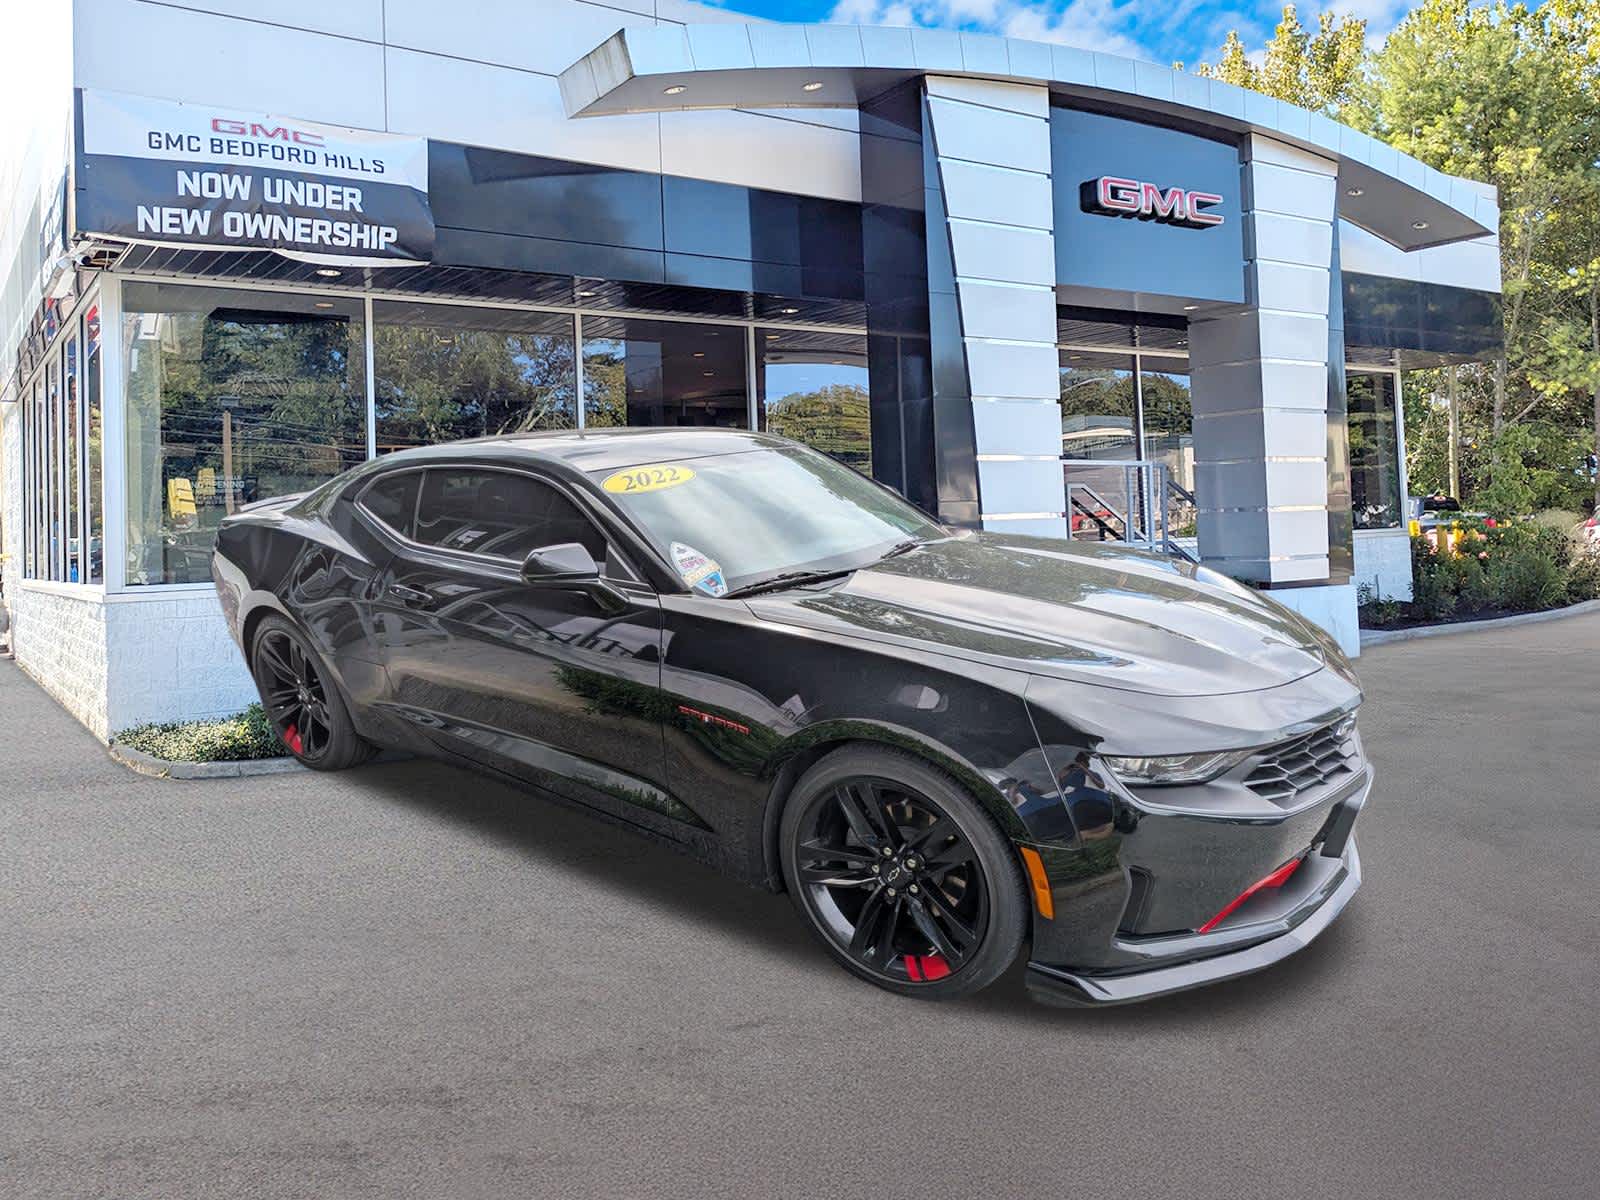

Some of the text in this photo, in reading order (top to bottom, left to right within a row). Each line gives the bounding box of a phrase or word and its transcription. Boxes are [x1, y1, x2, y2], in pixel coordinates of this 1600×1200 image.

[148, 131, 384, 174] GMC BEDFORD HILLS
[211, 118, 326, 148] GMC
[177, 170, 363, 213] NOW UNDER
[1098, 176, 1225, 225] GMC
[137, 205, 398, 250] NEW OWNERSHIP
[621, 467, 681, 491] 2022
